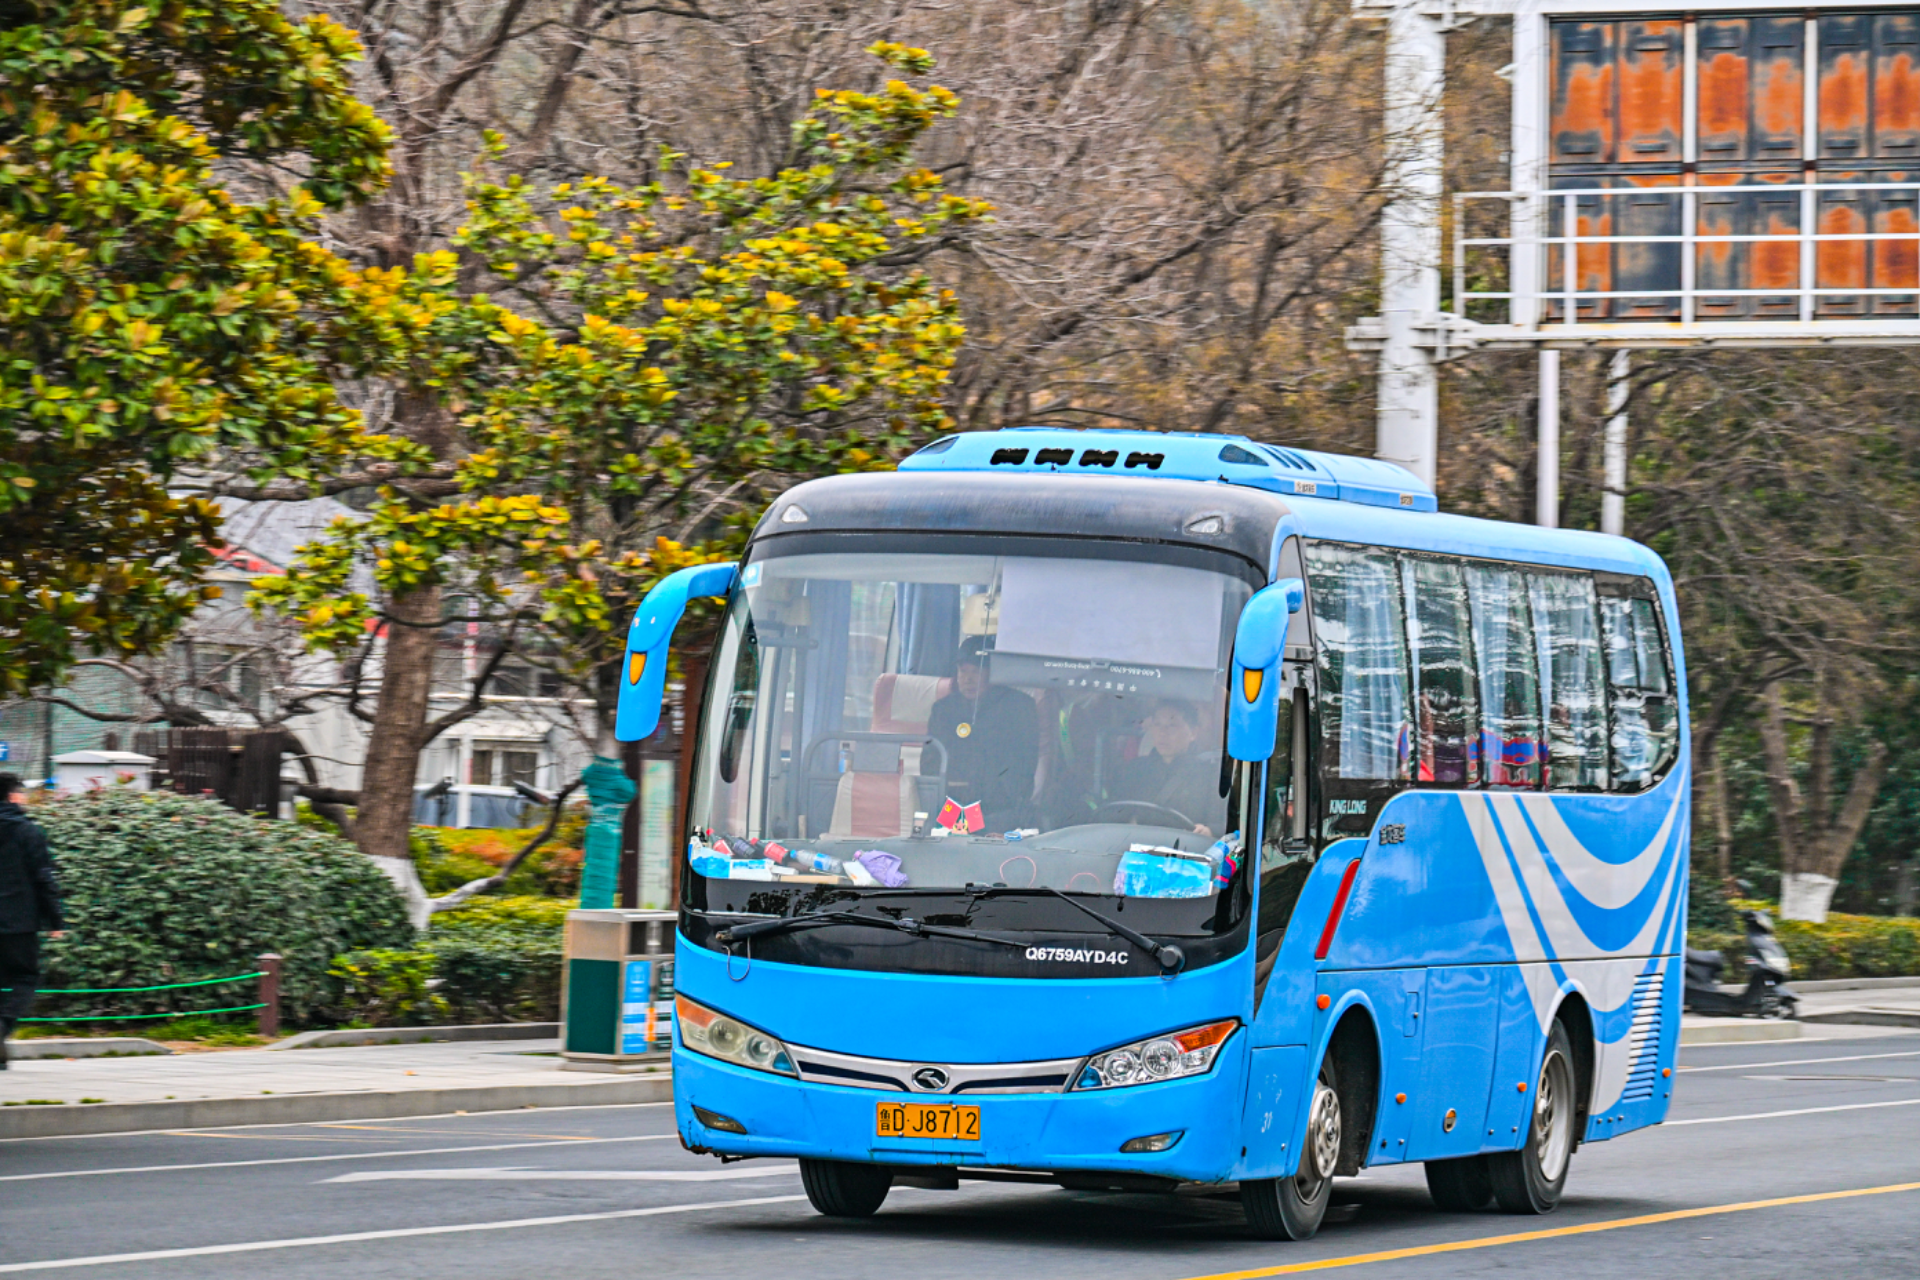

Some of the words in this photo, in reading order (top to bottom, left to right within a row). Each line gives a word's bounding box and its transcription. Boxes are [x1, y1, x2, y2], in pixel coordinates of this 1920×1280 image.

[1329, 800, 1347, 814] KING
[1347, 800, 1367, 814] LONG
[1025, 947, 1128, 964] Q6759AYD4C
